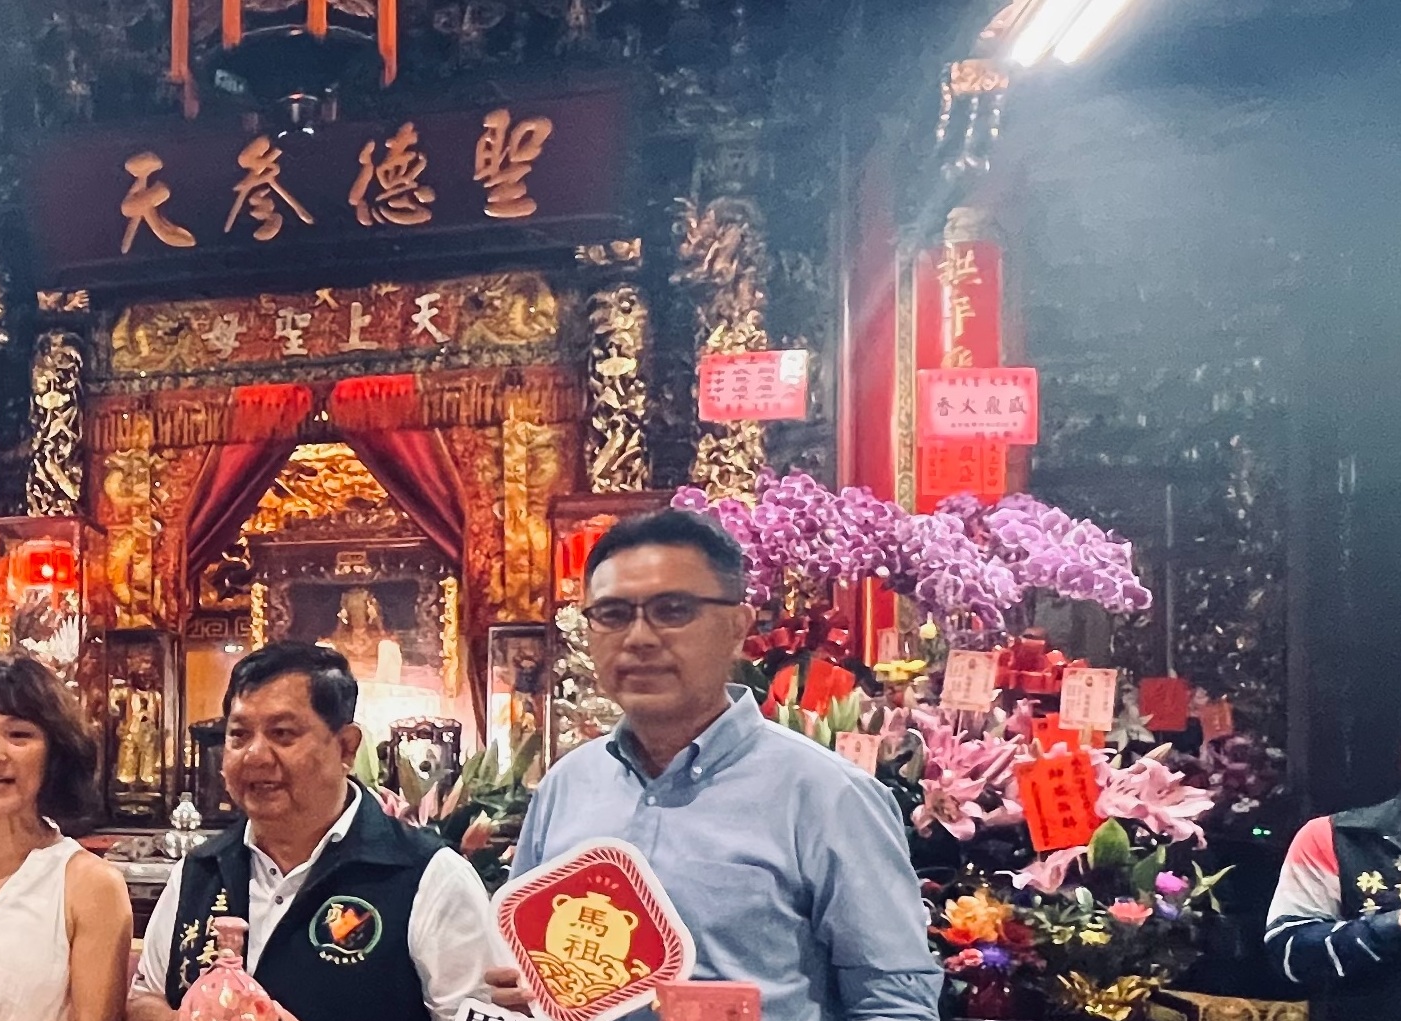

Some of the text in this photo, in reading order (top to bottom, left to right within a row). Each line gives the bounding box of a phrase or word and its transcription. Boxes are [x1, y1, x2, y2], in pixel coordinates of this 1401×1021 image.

[201, 293, 450, 359] 天上聖母
[562, 905, 609, 963] 馬祖
